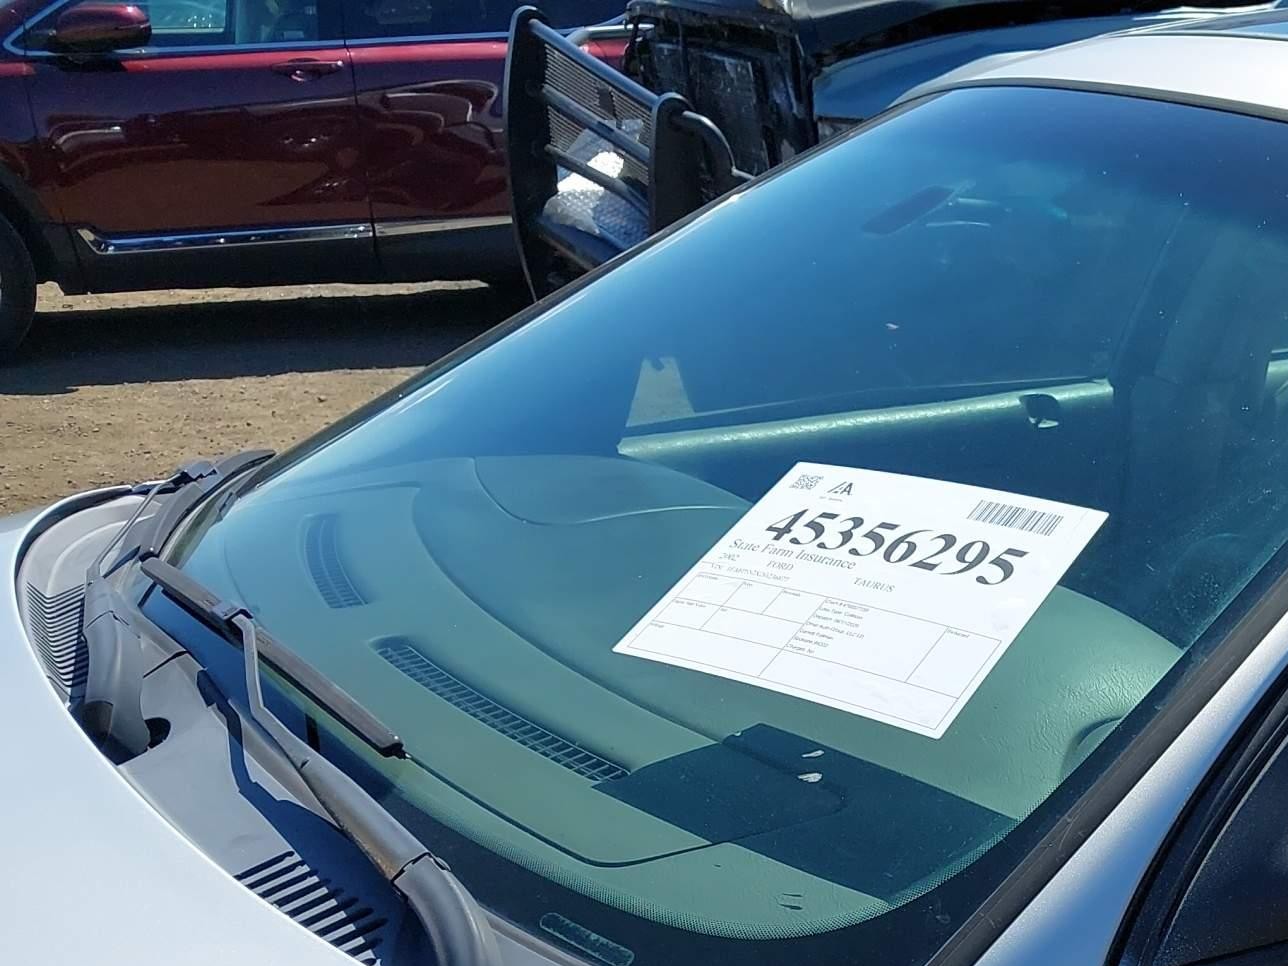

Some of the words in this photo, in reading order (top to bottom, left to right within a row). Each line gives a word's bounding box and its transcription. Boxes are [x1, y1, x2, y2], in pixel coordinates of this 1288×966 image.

[729, 538, 760, 553] State
[761, 542, 794, 559] Farm
[795, 549, 857, 571] Insurance
[765, 508, 1030, 585] 45356295
[766, 560, 795, 572] FORD
[853, 576, 896, 593] TAURUS
